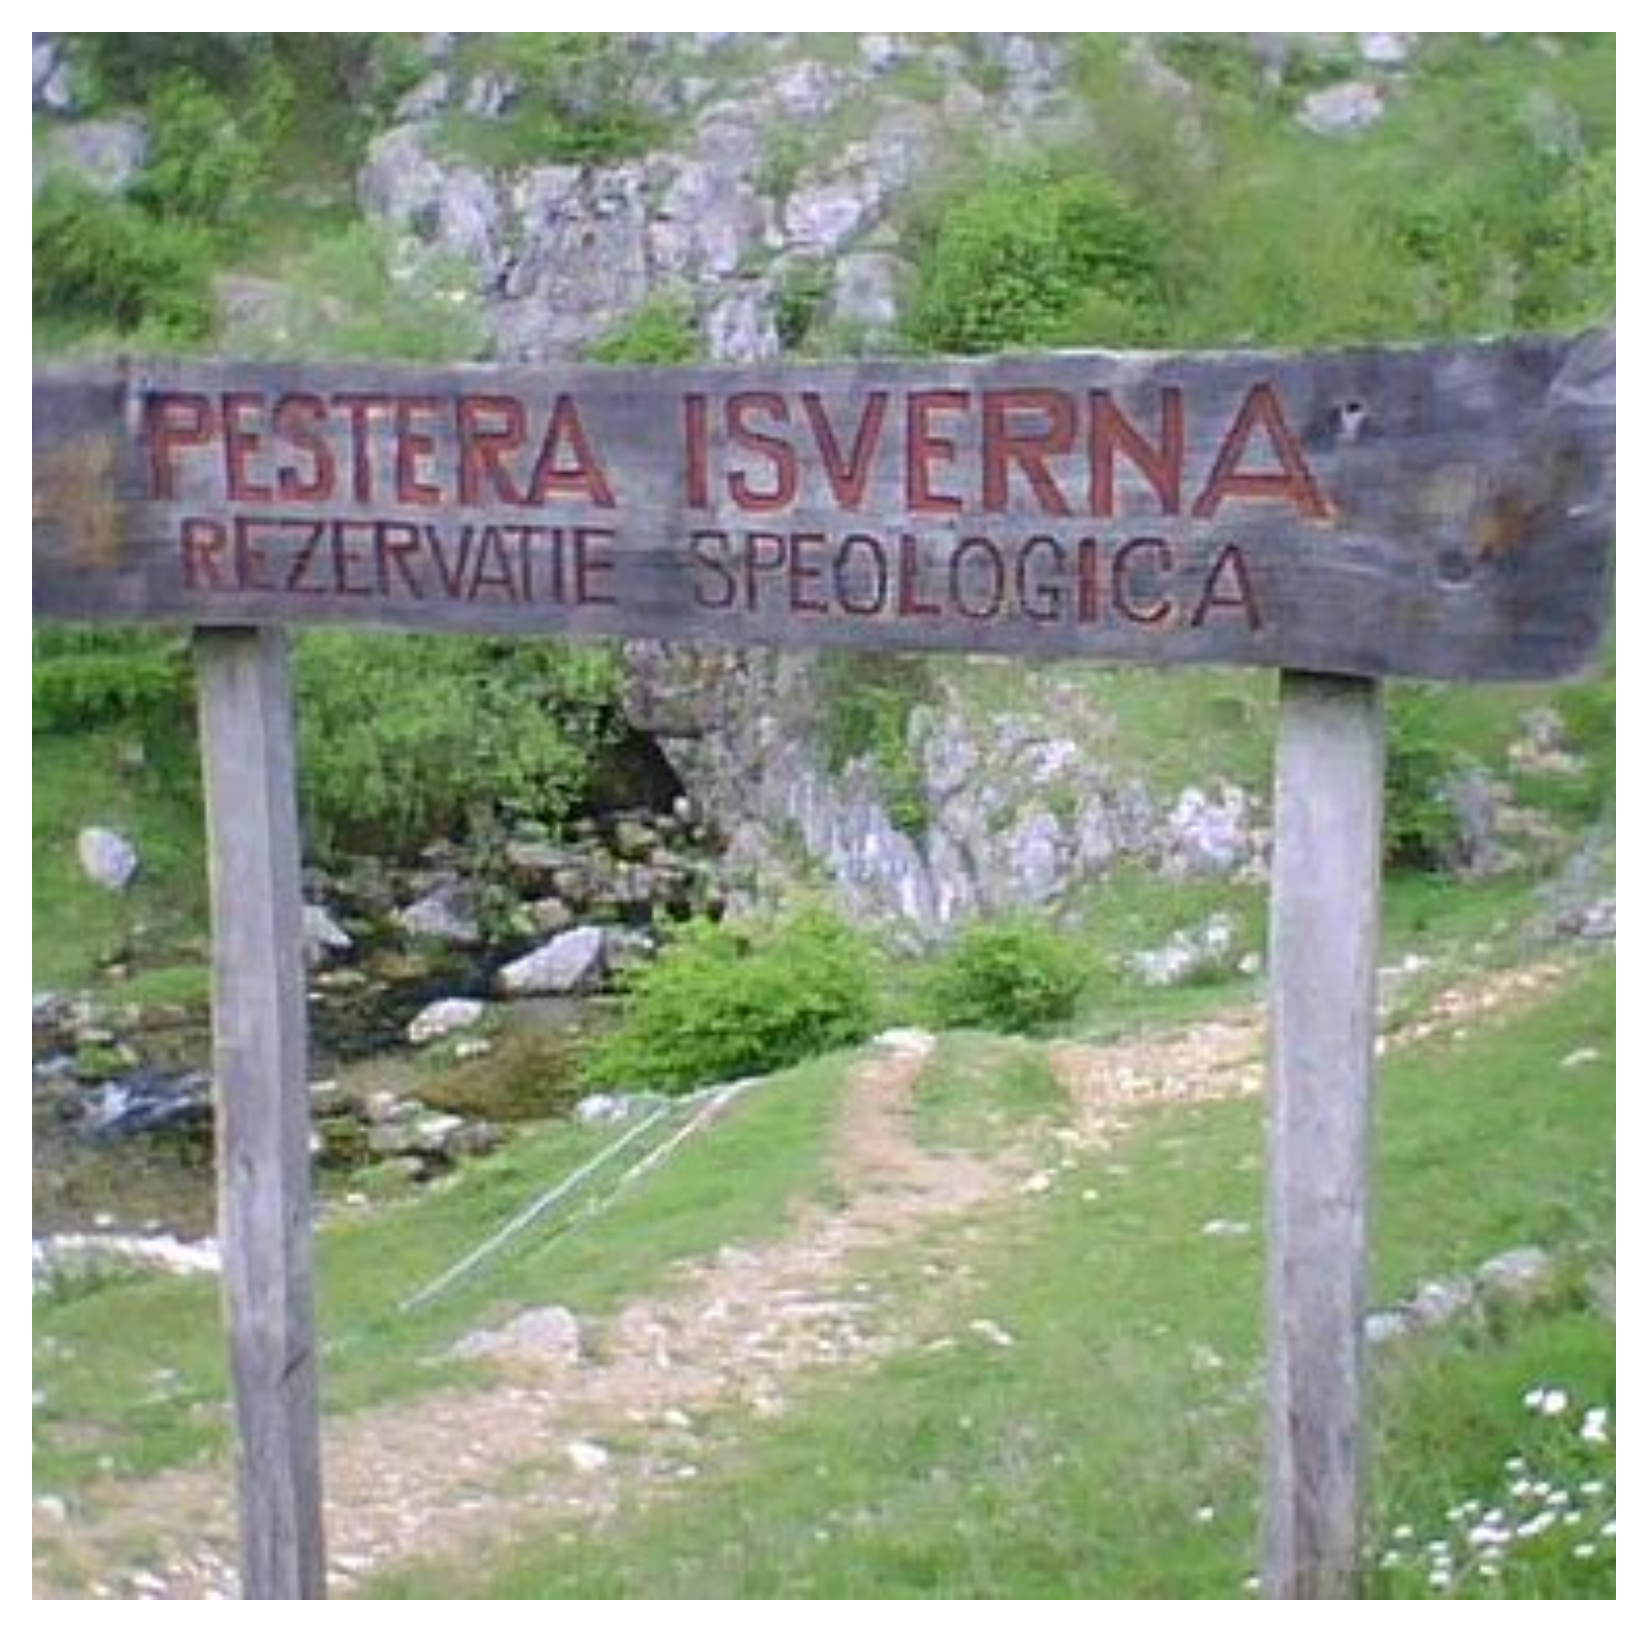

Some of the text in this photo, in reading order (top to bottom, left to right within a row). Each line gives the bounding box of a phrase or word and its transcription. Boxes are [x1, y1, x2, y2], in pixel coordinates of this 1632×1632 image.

[145, 382, 1336, 518] PESTERA ISVERNA
[180, 516, 1262, 630] REZERVATIE SPEOLOGICA
